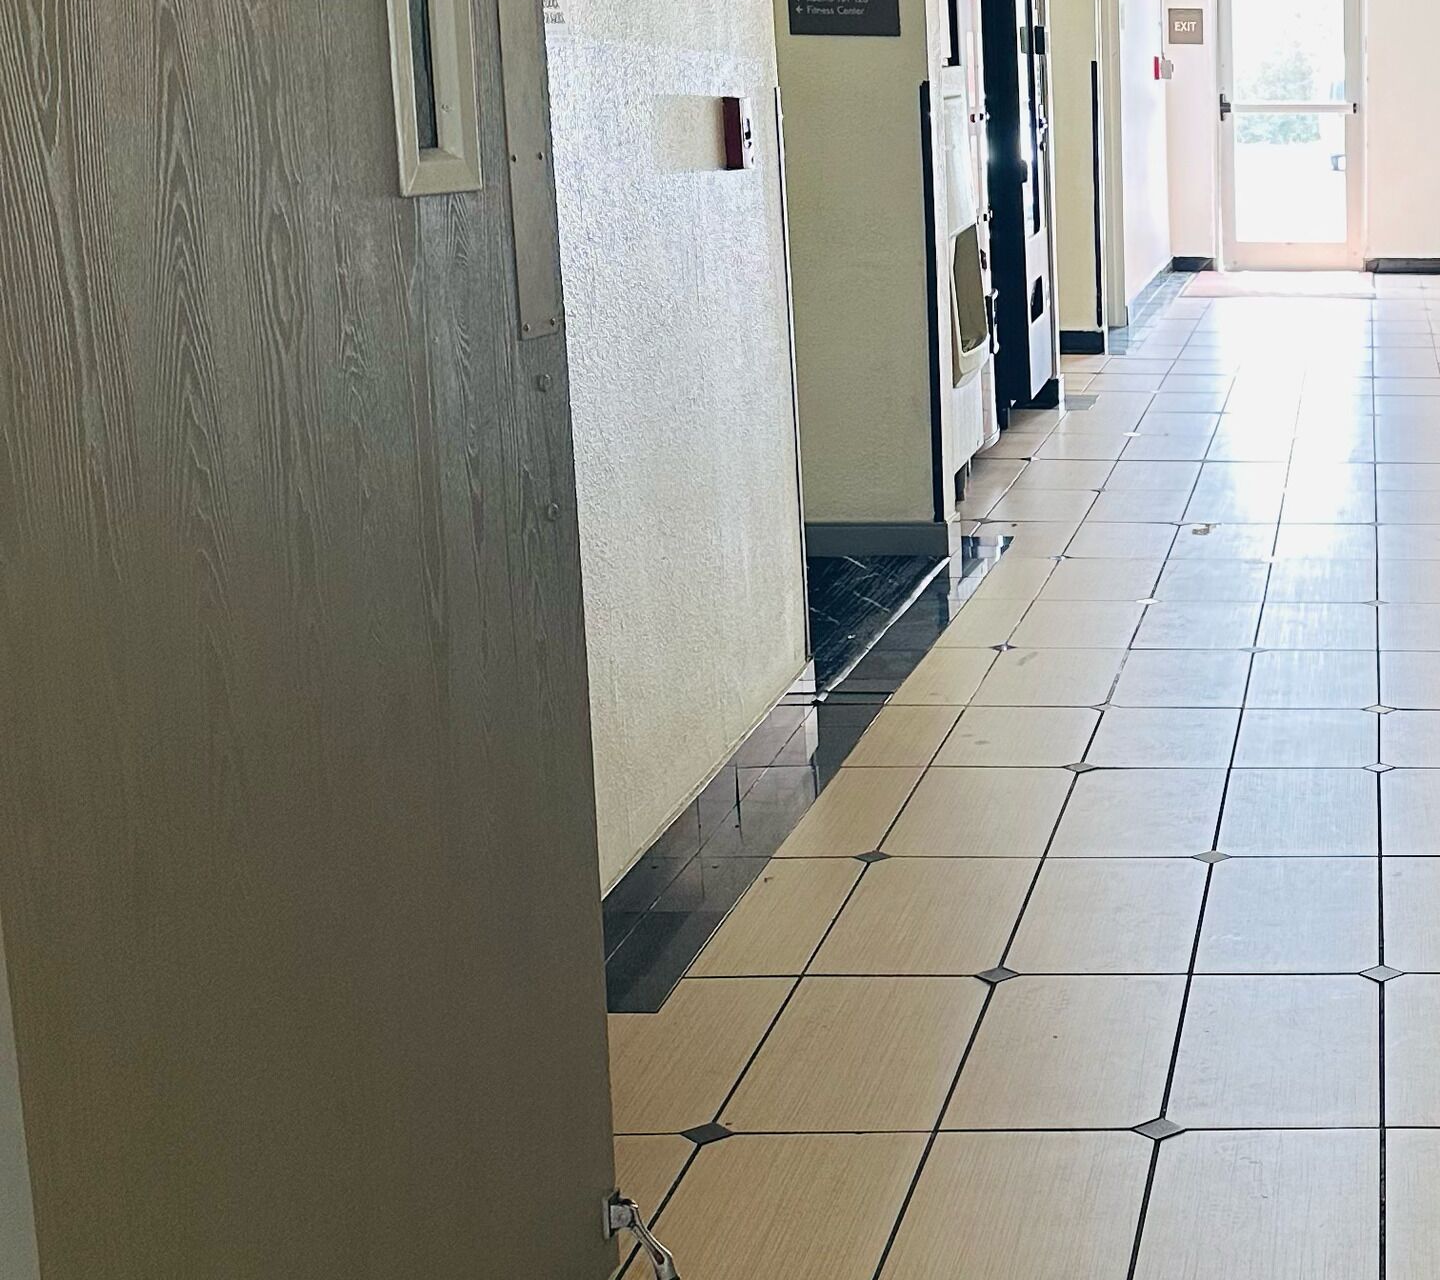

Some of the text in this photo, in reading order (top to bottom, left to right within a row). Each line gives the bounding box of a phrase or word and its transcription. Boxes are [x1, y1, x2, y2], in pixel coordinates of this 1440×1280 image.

[807, 6, 864, 15] Fitness Center
[1174, 22, 1197, 31] EXIT
